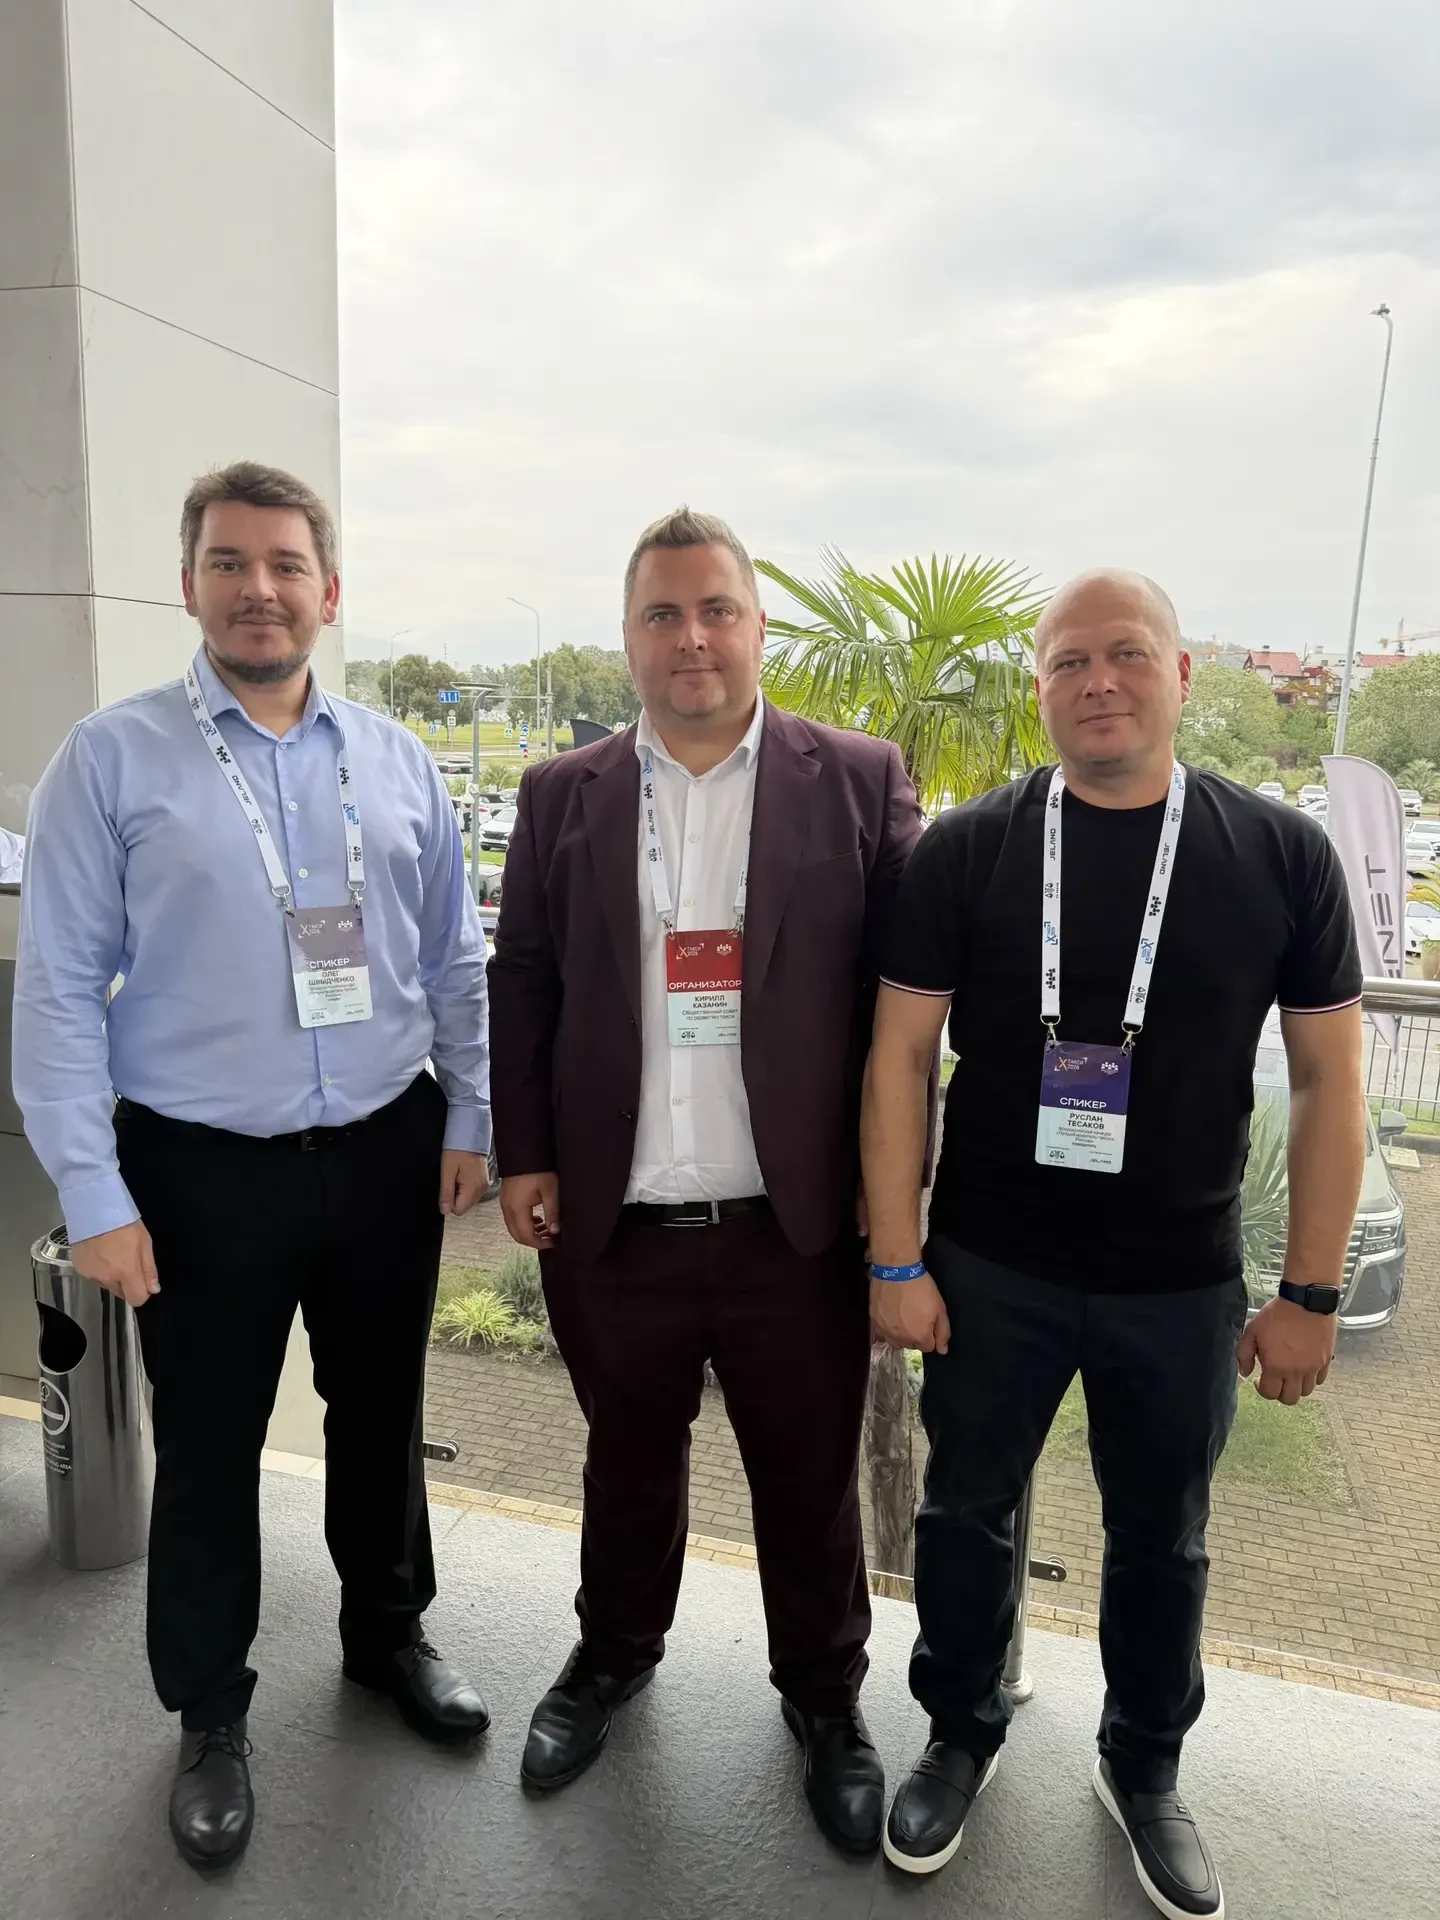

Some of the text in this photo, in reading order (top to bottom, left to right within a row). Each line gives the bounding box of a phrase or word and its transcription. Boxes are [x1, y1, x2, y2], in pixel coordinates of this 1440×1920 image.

[1159, 842, 1170, 875] JELAND
[309, 957, 350, 969] СПИКЕР
[308, 976, 355, 986] ШВЫДЧЕНКО
[668, 980, 742, 990] ОРГАНИЗАТОР
[1059, 1097, 1107, 1109] СПИКЕР
[1069, 1113, 1103, 1122] РУСЛАН
[1067, 1120, 1105, 1130] ТЕСАКОВ
